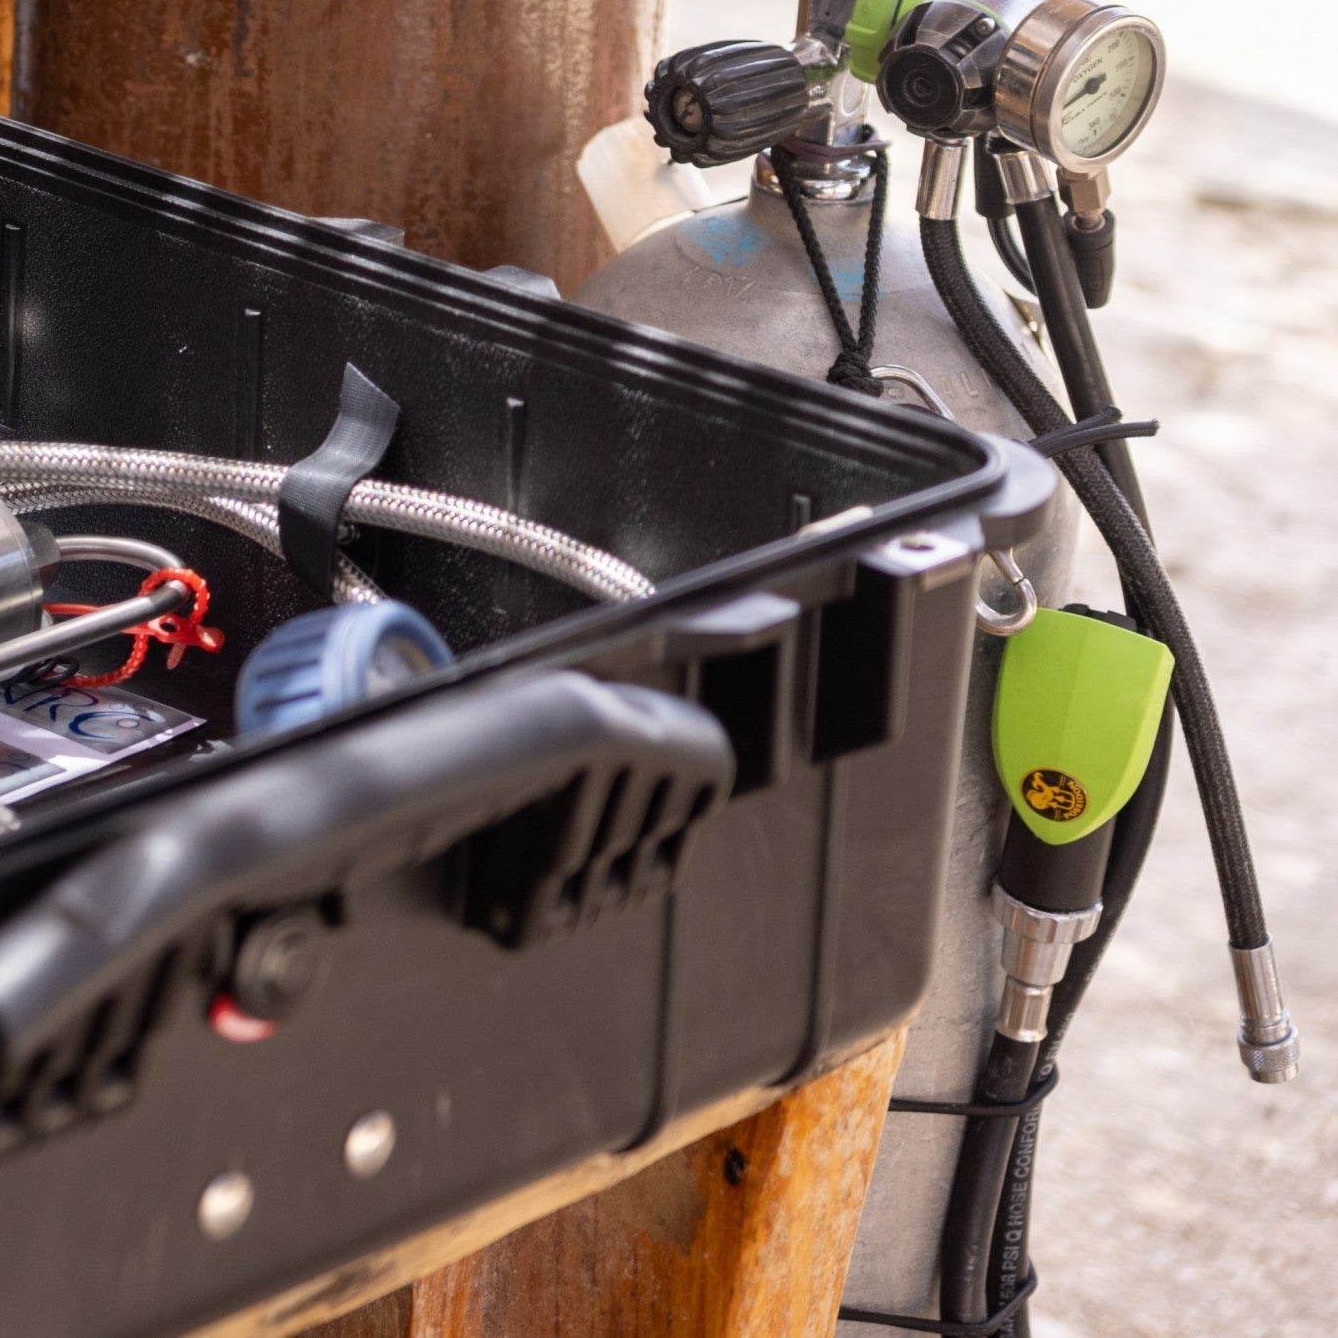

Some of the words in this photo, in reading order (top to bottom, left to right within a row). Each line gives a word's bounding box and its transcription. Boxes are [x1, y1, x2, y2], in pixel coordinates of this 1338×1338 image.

[1074, 57, 1103, 83] OXYGEN
[1006, 1181, 1029, 1227] HOSE
[1005, 1228, 1023, 1243] Q
[1002, 1245, 1020, 1271] PSI
